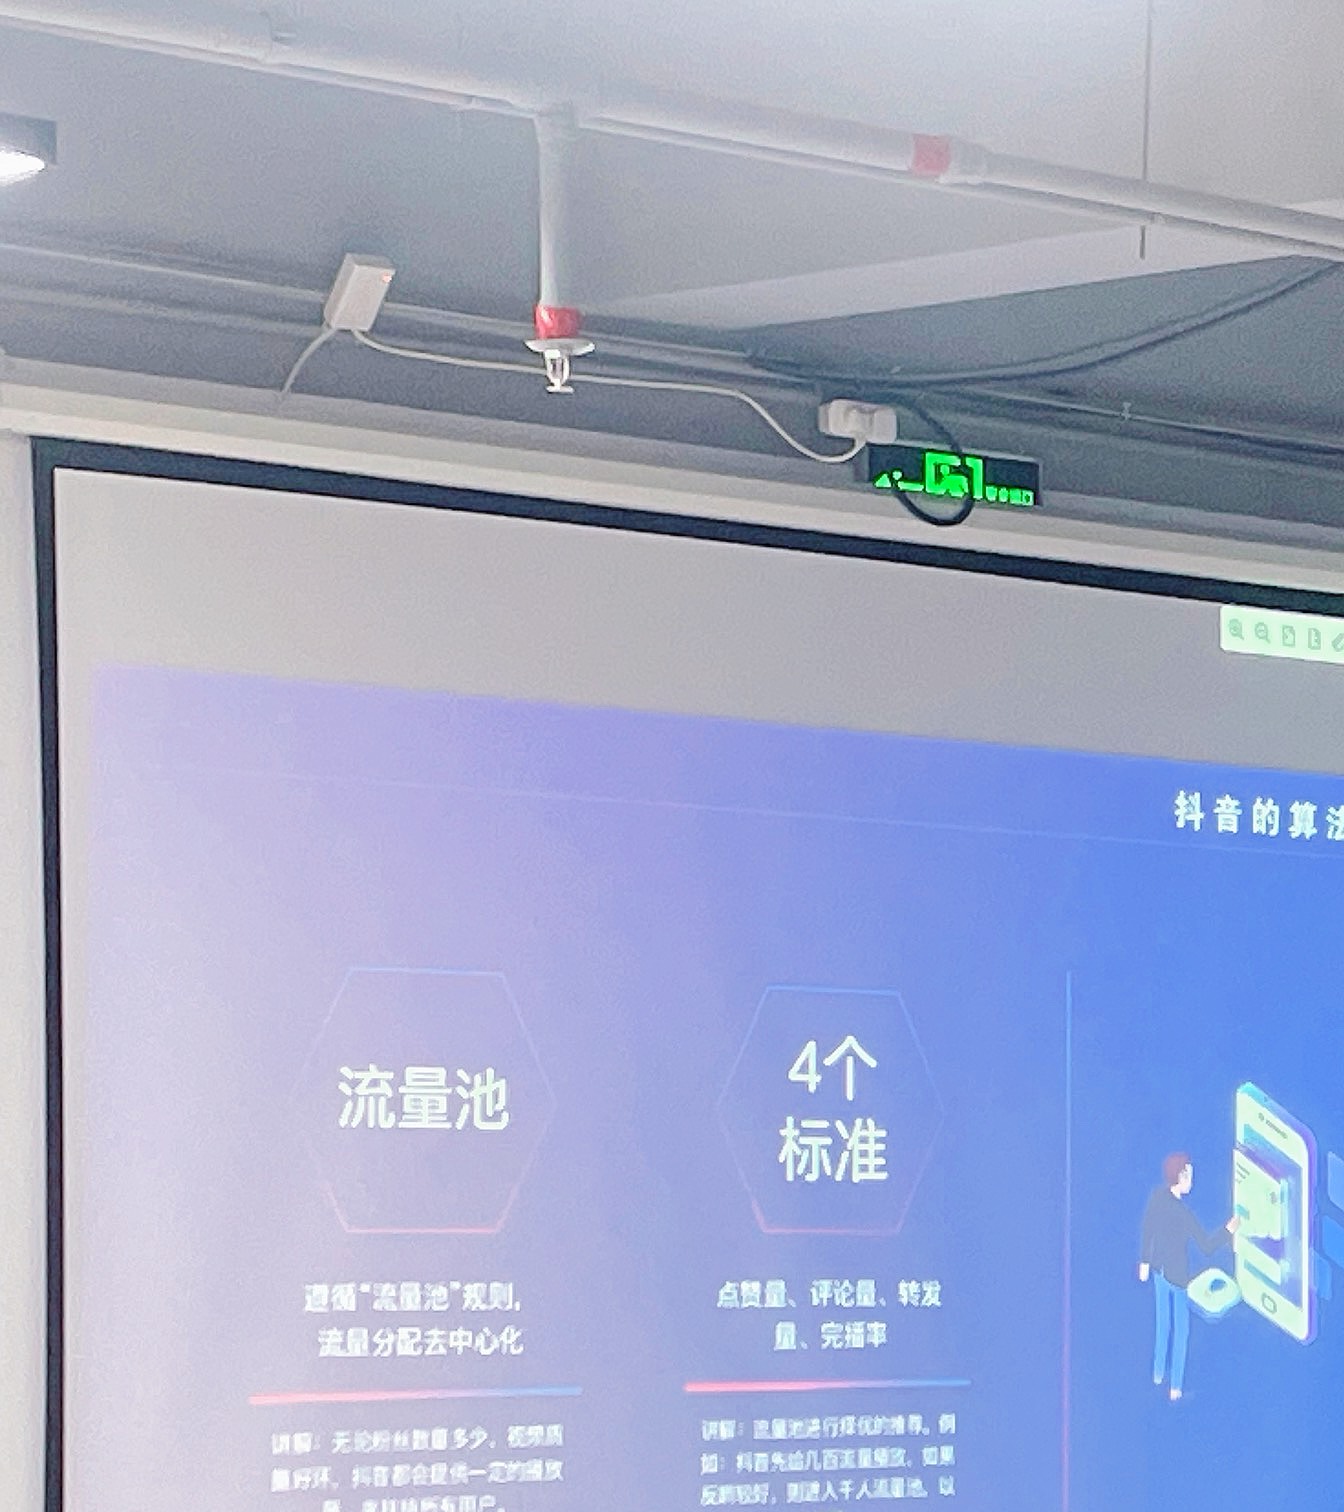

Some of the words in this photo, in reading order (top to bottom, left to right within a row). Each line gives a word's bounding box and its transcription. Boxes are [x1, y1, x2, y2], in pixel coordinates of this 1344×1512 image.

[337, 1064, 510, 1131] 流量池
[787, 1034, 878, 1101] 4个
[778, 1117, 889, 1183] 标准
[318, 1326, 525, 1357] 流量分配去中心化
